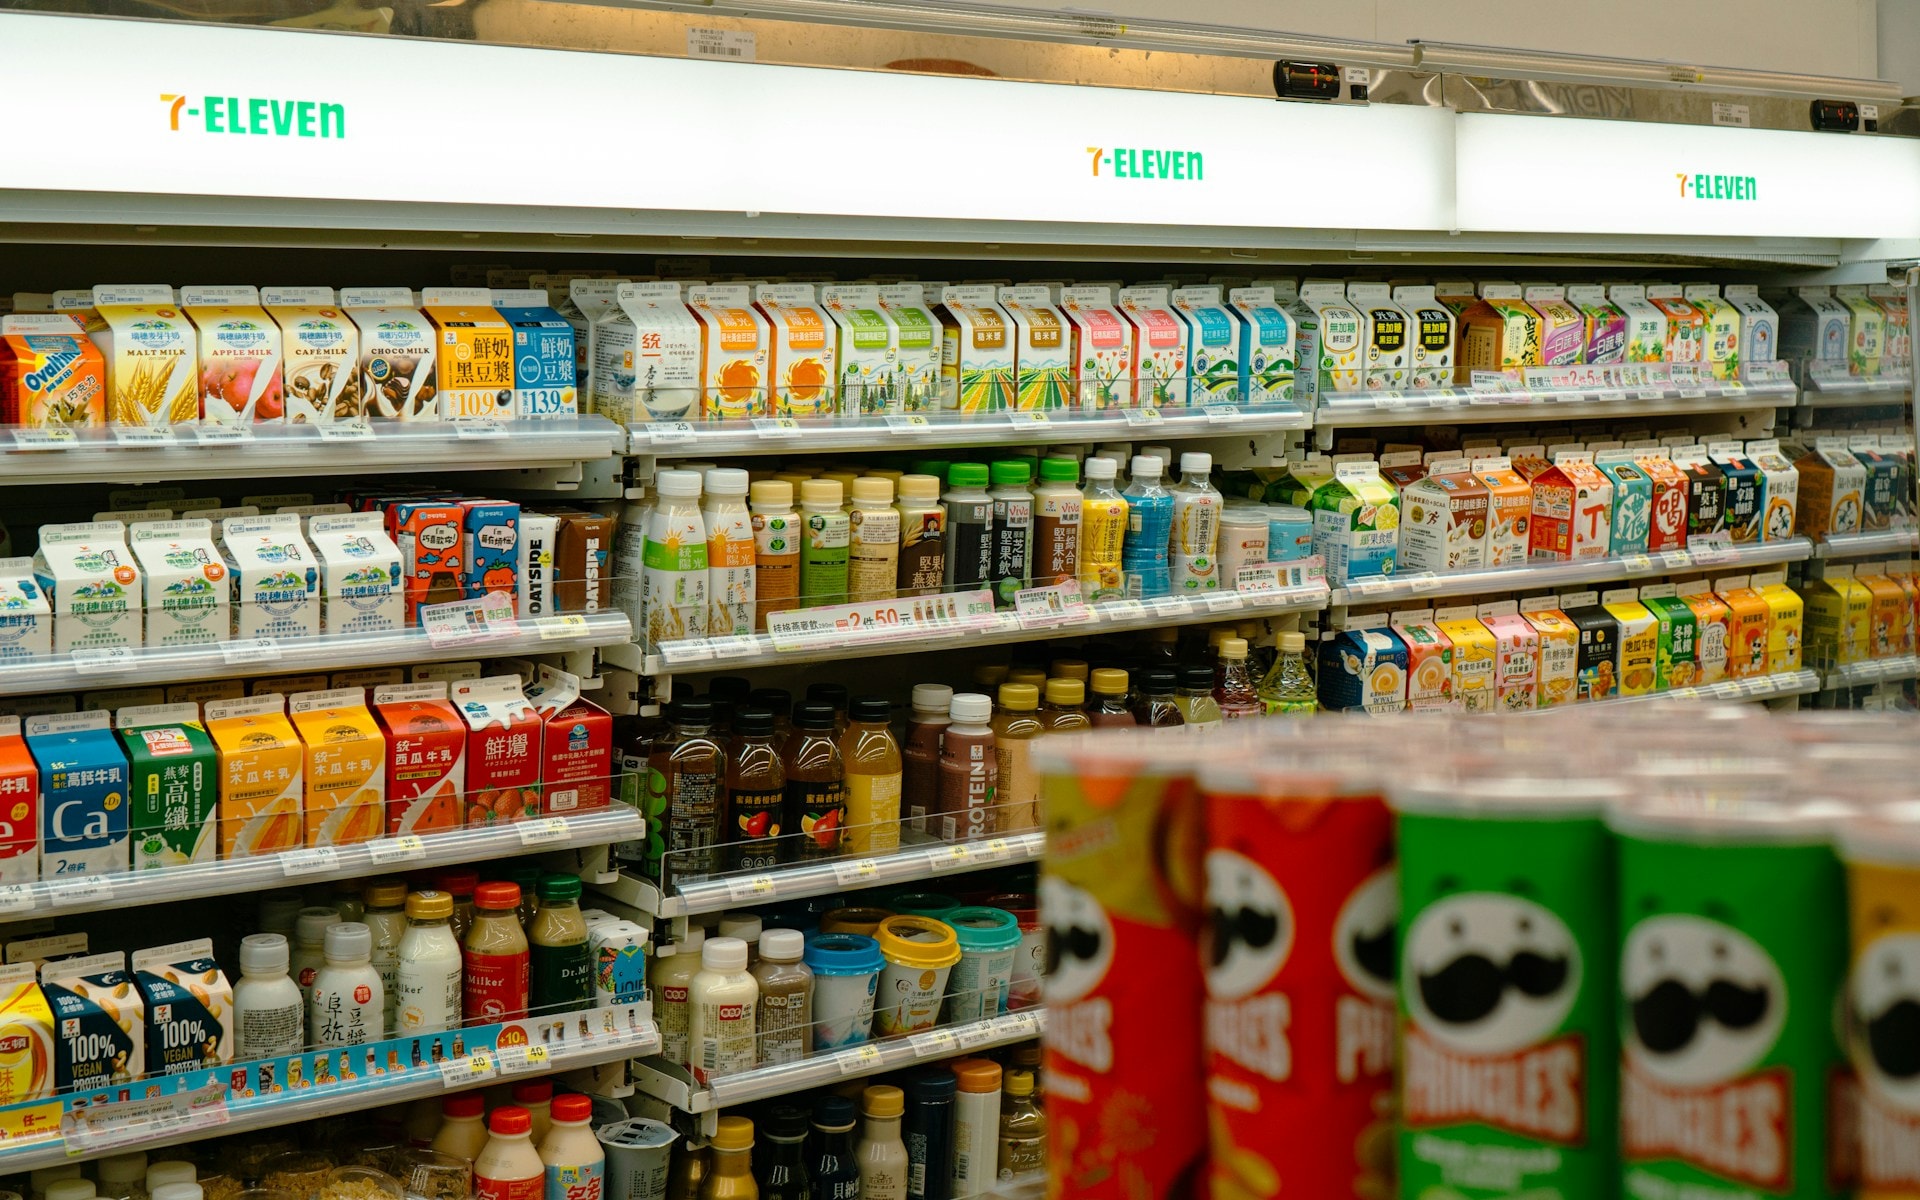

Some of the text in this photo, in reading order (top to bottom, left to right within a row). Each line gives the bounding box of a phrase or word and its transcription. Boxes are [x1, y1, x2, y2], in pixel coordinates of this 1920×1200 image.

[1329, 322, 1356, 334] 無加糖
[1376, 322, 1402, 334] 無加糖
[1422, 322, 1448, 334] 無加糖
[473, 337, 511, 361] 鮮奶
[540, 336, 573, 360] 鮮奶
[1546, 329, 1582, 354] 一日蔬果
[1588, 332, 1625, 355] 一日蔬果
[406, 347, 430, 355] MILK
[456, 361, 512, 384] 黑豆漿
[542, 361, 573, 382] 豆漿
[66, 374, 98, 402] 巧克力
[675, 422, 687, 433] 25
[1700, 492, 1720, 506] 莫卡
[1737, 487, 1755, 501] 拿鐵
[1659, 491, 1682, 526] 喝
[1699, 506, 1719, 520] 咖啡
[1735, 501, 1754, 516] 咖啡
[678, 547, 704, 558] 統一
[726, 543, 751, 555] 統一
[978, 533, 990, 580] 堅果飲
[998, 530, 1012, 576] 堅果飲
[1052, 527, 1065, 572] 堅果飲
[678, 558, 704, 570] 陽光
[726, 554, 751, 566] 陽光
[529, 539, 543, 615] OATSIDE
[585, 537, 600, 614] OATSIDE
[255, 589, 308, 604] 瑞穗鮮乳
[340, 585, 392, 600] 瑞穗鮮乳
[70, 600, 128, 615] 瑞穗鮮乳
[162, 596, 218, 611] 瑞穗鮮乳
[568, 616, 579, 625] 39
[1624, 638, 1657, 653] 地瓜牛奶
[1373, 696, 1395, 705] ROYAL
[1387, 703, 1401, 713] TEA
[396, 740, 423, 752] 統一
[485, 733, 528, 761] 鮮攪
[314, 752, 341, 763] 統一
[395, 750, 453, 766] 西瓜牛乳
[163, 764, 190, 781] 燕麥
[229, 760, 258, 772] 統一
[314, 759, 373, 776] 木瓜牛乳
[67, 767, 123, 787] 高鈣牛乳
[229, 767, 291, 785] 木瓜牛乳
[164, 780, 190, 832] 高纖
[52, 800, 109, 843] Ca
[56, 859, 87, 875] 2倍鈣
[148, 982, 173, 993] 100%
[57, 996, 81, 1006] 100%
[321, 991, 345, 1043] 阜杭
[1016, 1014, 1027, 1023] 30
[980, 1021, 991, 1031] 30
[160, 1019, 206, 1050] 100%
[69, 1034, 116, 1065] 100%
[164, 1047, 194, 1063] VEGAN
[530, 1046, 544, 1058] 40
[72, 1061, 102, 1078] VEGAN
[165, 1061, 201, 1077] PROTEIN
[472, 1057, 486, 1069] 40
[73, 1074, 110, 1092] PROTEIN
[22, 1114, 47, 1127] 任一
